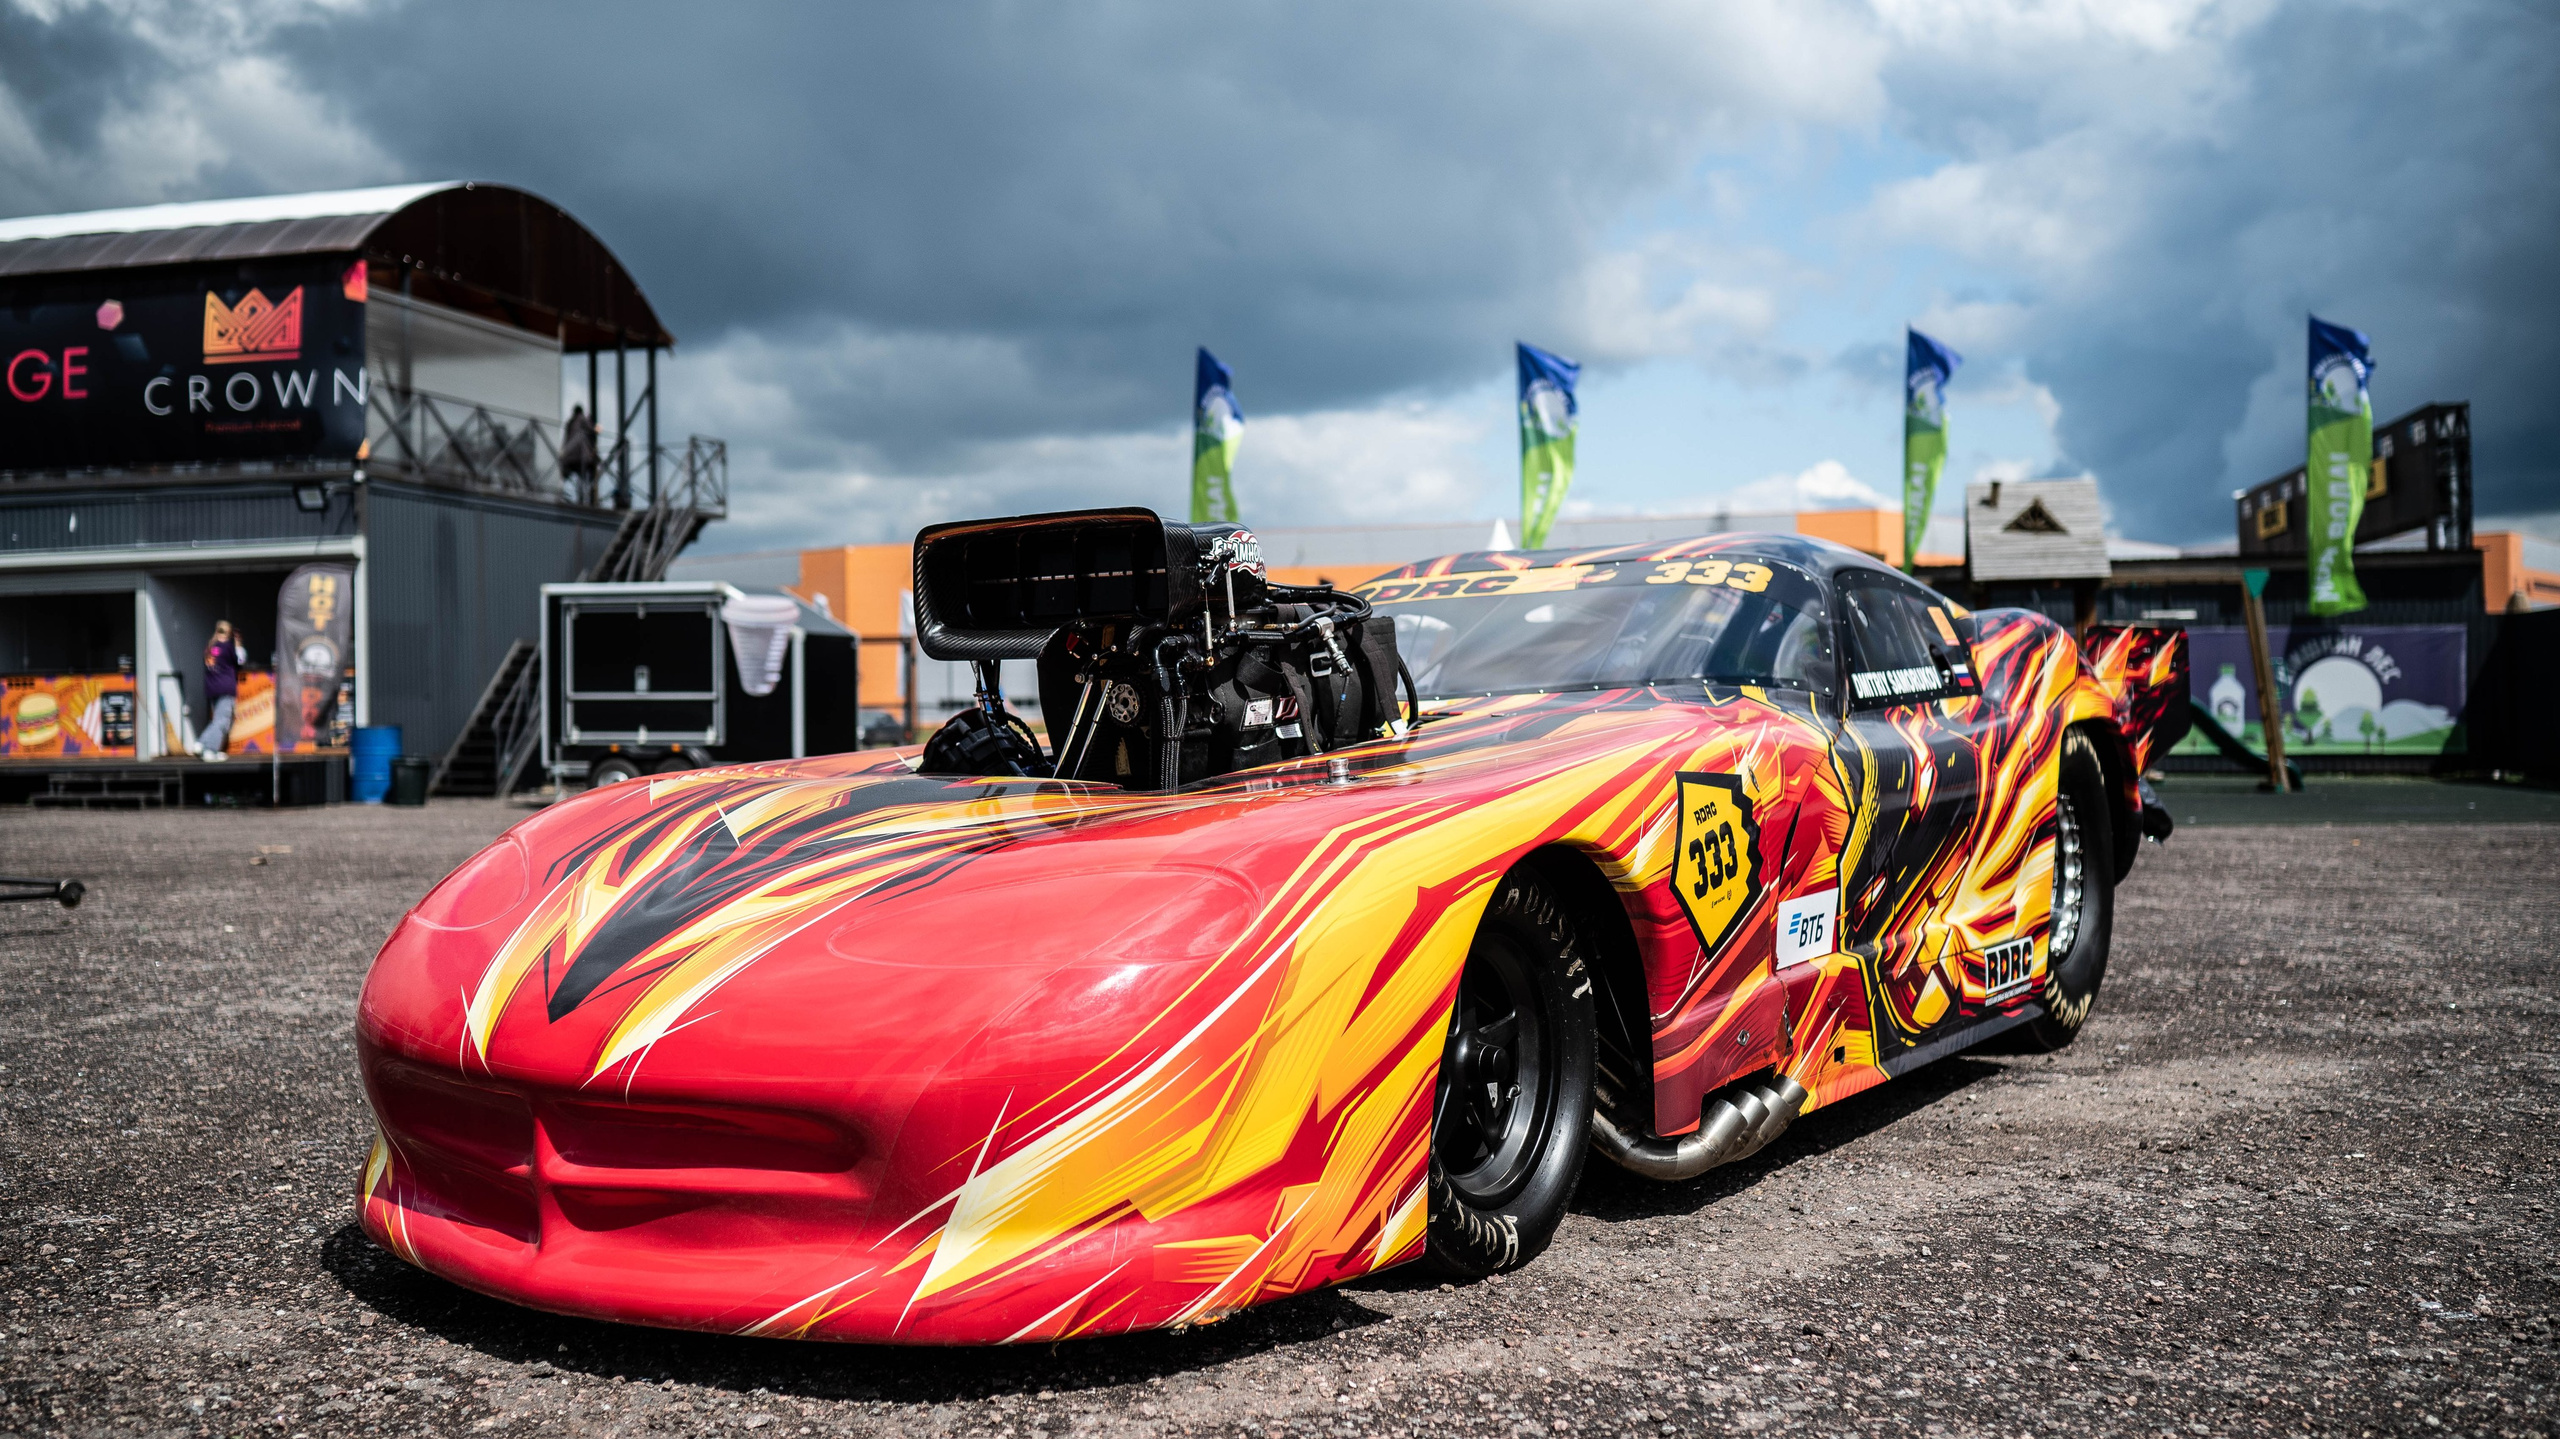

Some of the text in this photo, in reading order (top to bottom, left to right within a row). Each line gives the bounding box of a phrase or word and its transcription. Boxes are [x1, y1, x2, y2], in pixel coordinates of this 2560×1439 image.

[7, 346, 89, 402] GE
[144, 366, 368, 416] CROWN
[1645, 560, 1774, 594] 333
[1851, 665, 1943, 699] DMITRIY SAMORUKOV
[1693, 801, 1718, 826] RDRC
[1688, 820, 1739, 900] 333
[1799, 912, 1825, 948] ВТБ
[1986, 941, 2032, 990] RDRC
